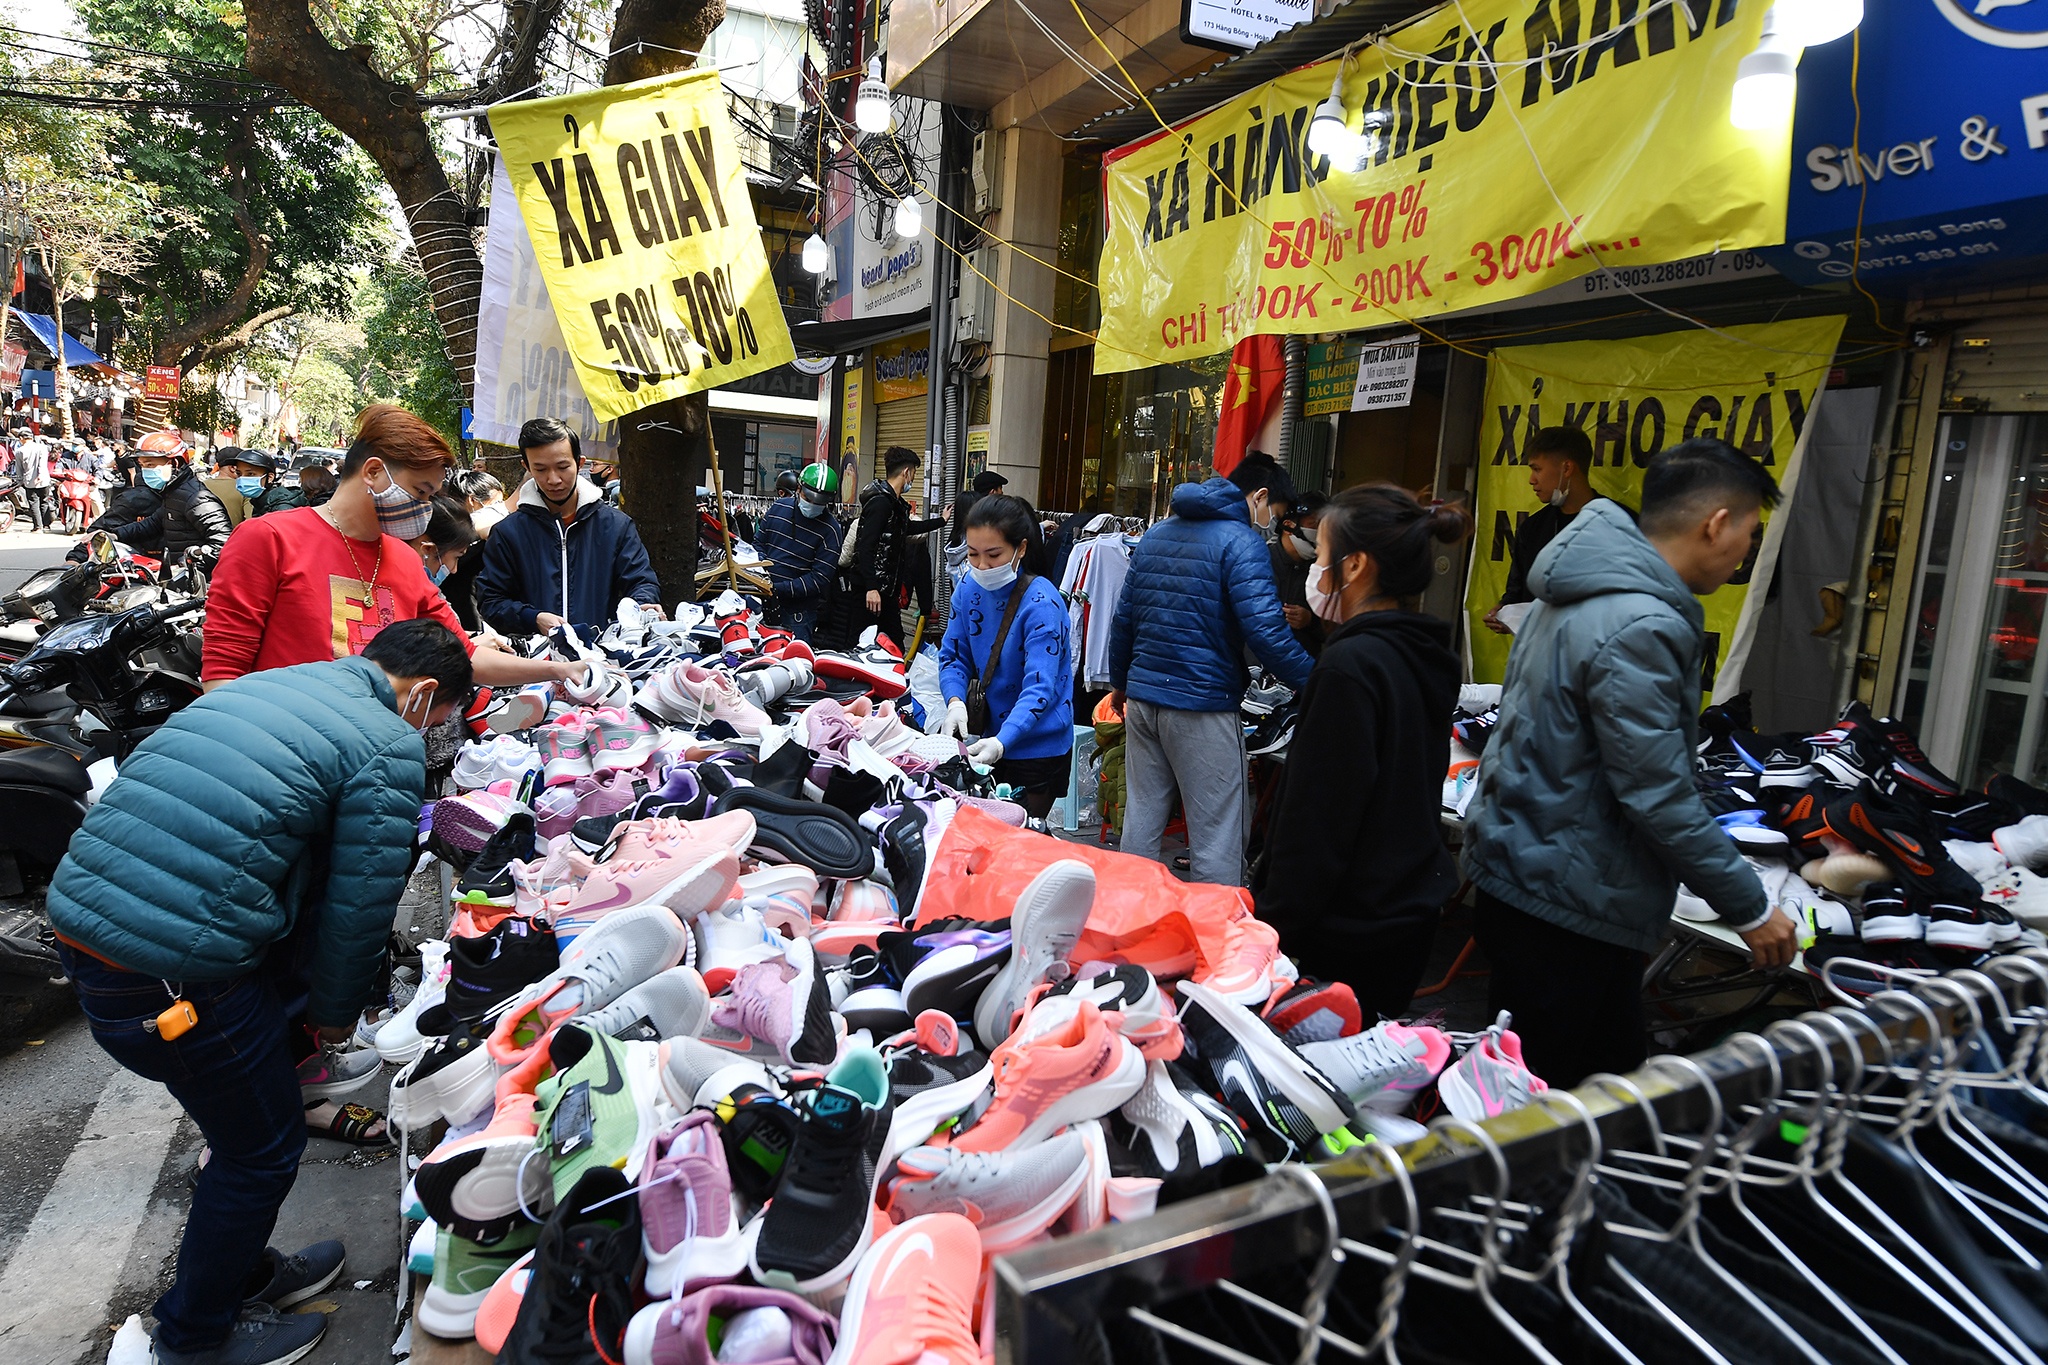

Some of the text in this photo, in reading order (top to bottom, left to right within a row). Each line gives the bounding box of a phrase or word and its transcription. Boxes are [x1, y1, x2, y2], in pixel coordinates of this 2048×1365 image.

[1203, 20, 1215, 29] 173
[1230, 7, 1254, 19] HOTEL
[1264, 15, 1279, 25] SPA
[1806, 136, 1938, 192] Silver
[1959, 115, 2008, 162] &
[531, 111, 729, 268] XẢ GIÀY
[1143, 133, 1194, 249] XẢ
[1875, 229, 1938, 246] Hang
[1939, 217, 2007, 236] Bong
[862, 256, 885, 288] beard
[1584, 274, 1609, 293] ĐT:
[1614, 257, 1716, 289] 0903.288207
[1161, 302, 1207, 349] CHỈ
[1350, 254, 1433, 314] 200K
[875, 348, 905, 383] beard
[1363, 349, 1380, 365] MUA
[1308, 364, 1326, 382] THÁI
[147, 381, 161, 392] 50%
[165, 383, 178, 394] 70%
[1308, 382, 1331, 400] ĐẶC
[1358, 384, 1370, 393] LH:
[608, 738, 630, 749] NIKE
[561, 748, 581, 758] NIKE
